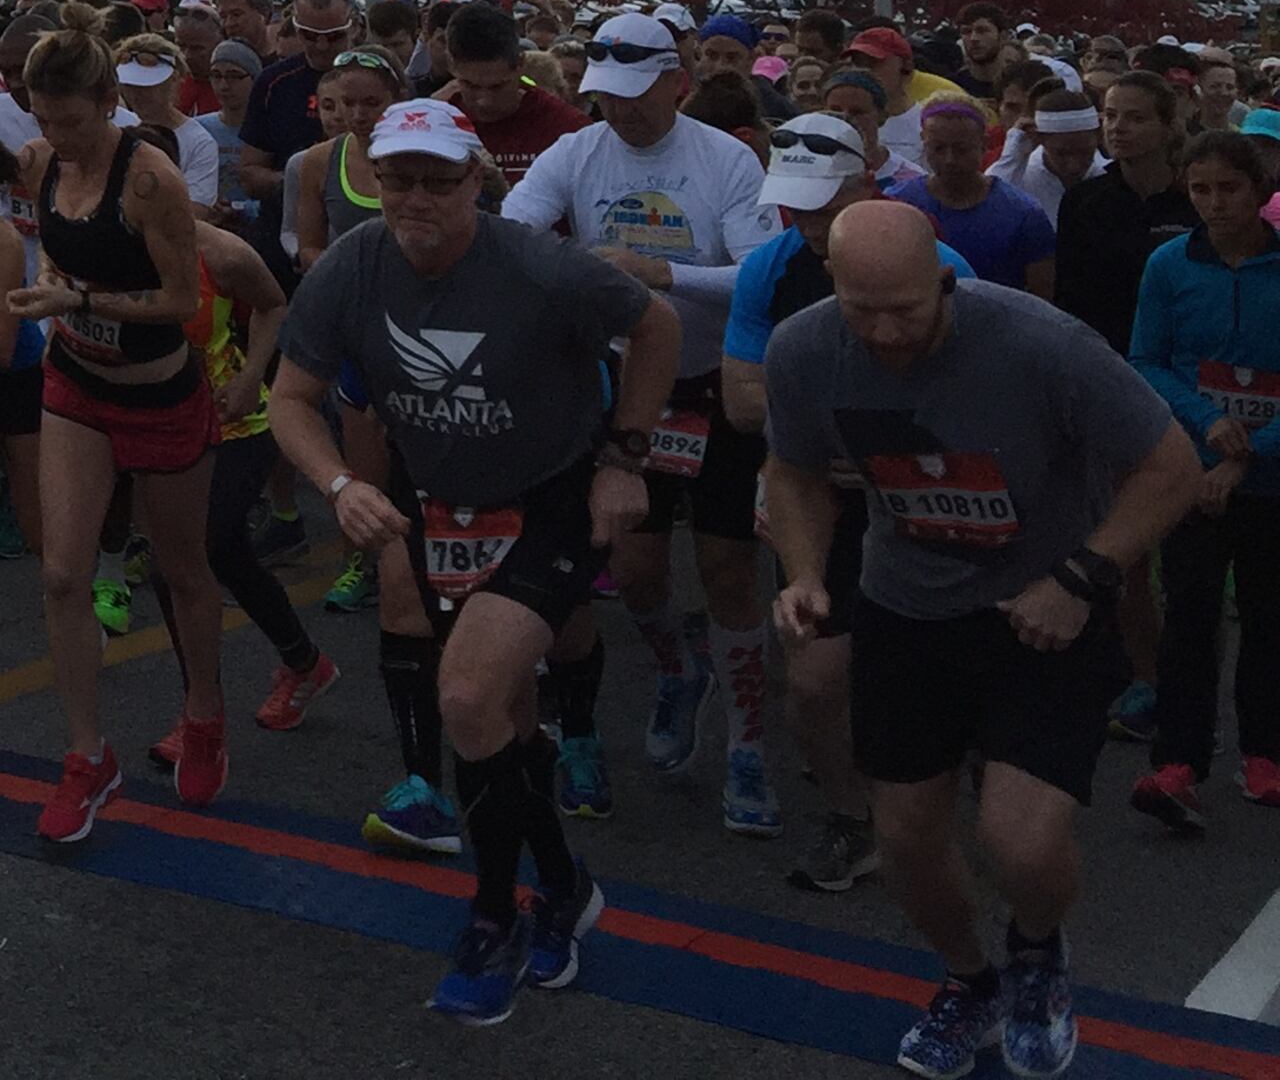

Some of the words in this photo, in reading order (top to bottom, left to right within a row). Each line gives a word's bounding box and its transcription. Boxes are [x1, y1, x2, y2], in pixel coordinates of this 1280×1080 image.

[12, 200, 21, 214] B
[384, 390, 513, 425] ATLANTA
[918, 494, 1008, 519] 10810
